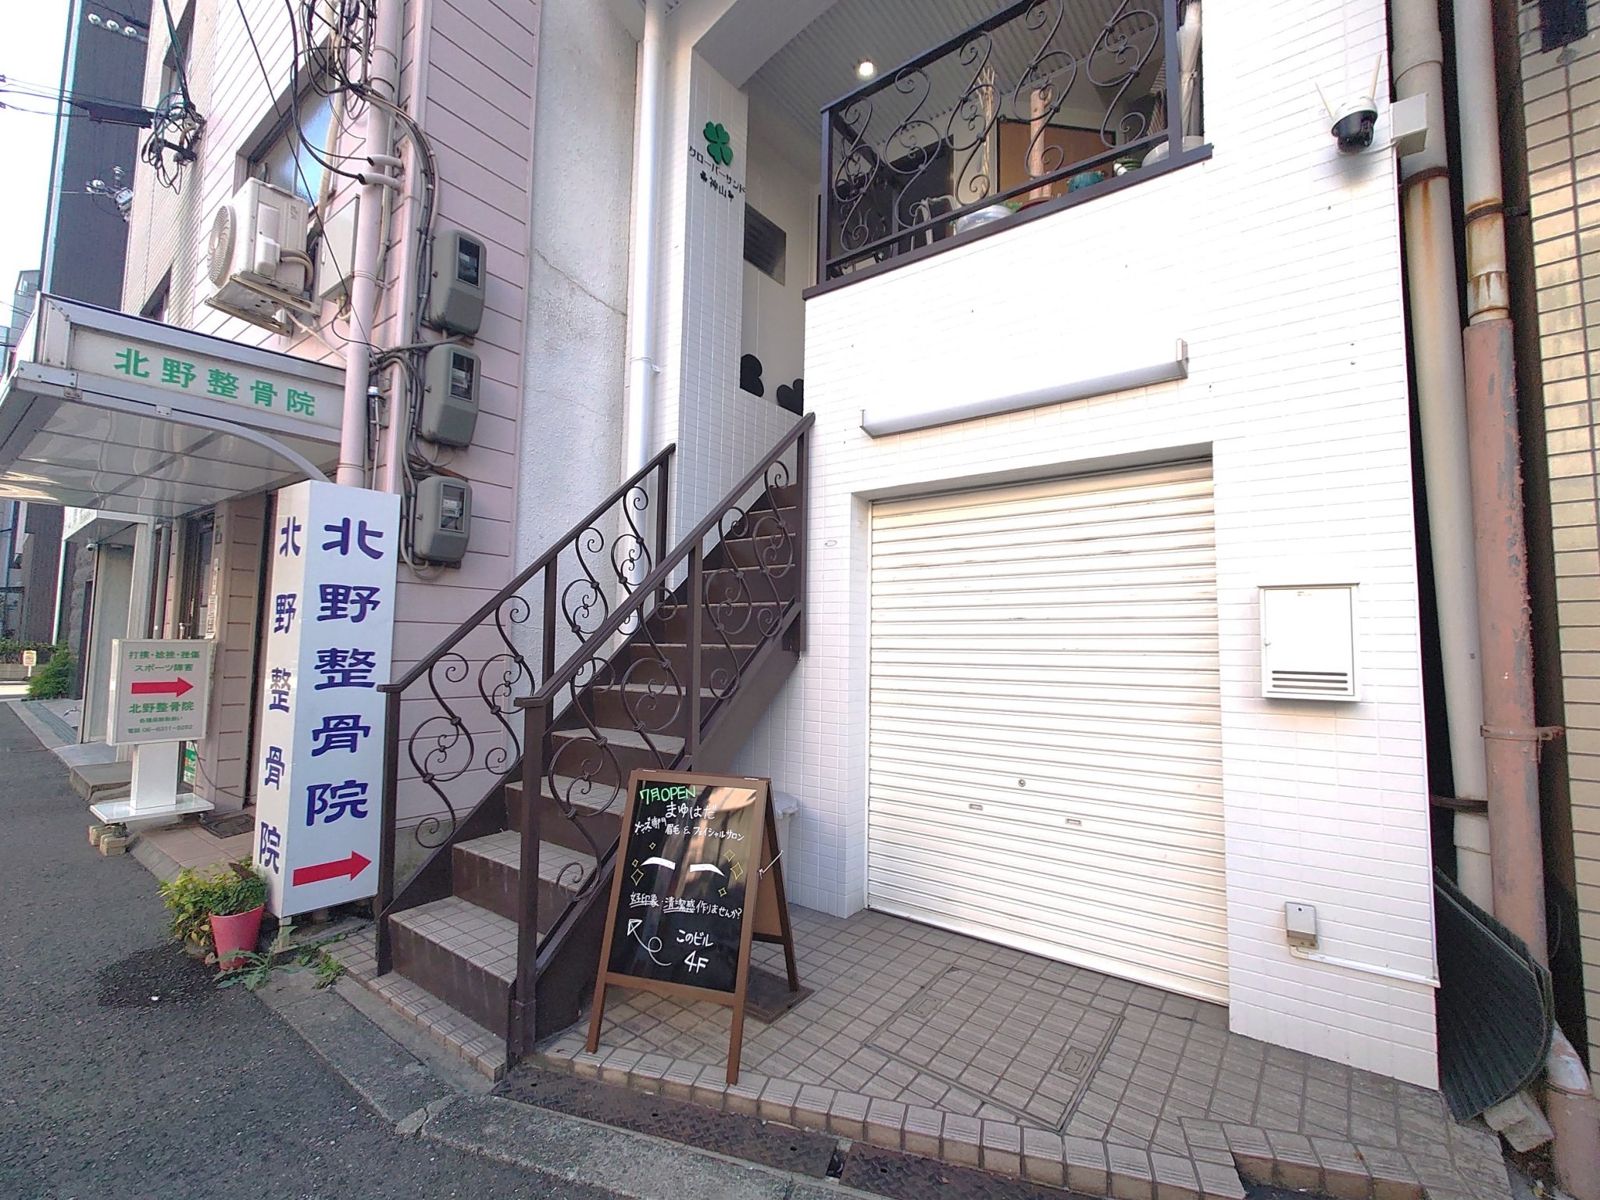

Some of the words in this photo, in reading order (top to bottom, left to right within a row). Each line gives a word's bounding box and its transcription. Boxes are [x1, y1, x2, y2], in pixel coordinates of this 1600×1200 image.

[688, 145, 746, 195] クローバーサンド
[709, 176, 727, 198] 神山
[113, 347, 317, 418] 北野整骨院
[134, 663, 194, 673] スポーツ障害
[305, 517, 386, 827] 北野整骨院
[258, 516, 302, 875] 北野整骨院
[128, 702, 195, 714] 北野整骨院
[676, 928, 715, 948] このビル
[684, 950, 709, 974] 4F
